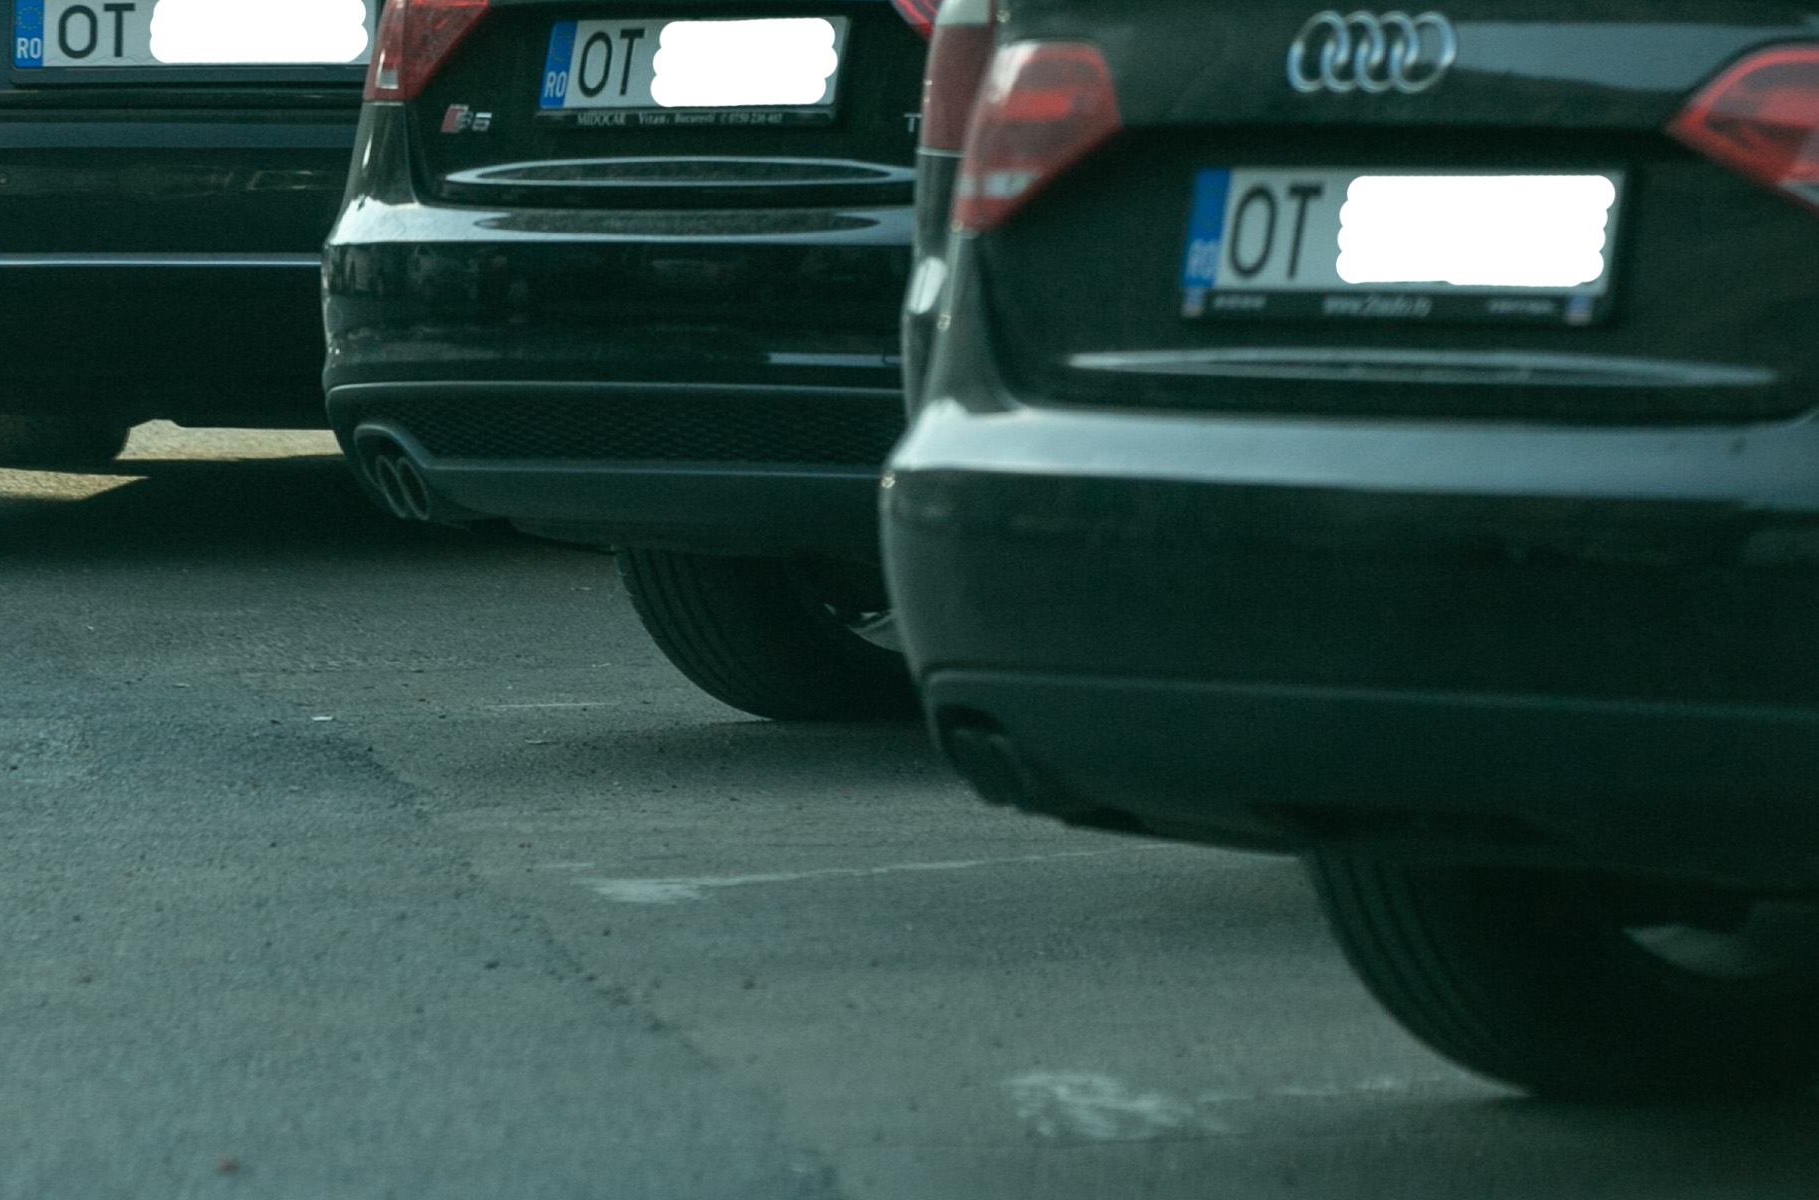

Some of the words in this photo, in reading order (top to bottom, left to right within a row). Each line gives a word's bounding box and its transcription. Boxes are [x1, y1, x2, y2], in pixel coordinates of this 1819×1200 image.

[16, 37, 43, 60] RO
[57, 2, 136, 59] OT
[577, 27, 646, 98] OT
[544, 70, 568, 99] RO
[903, 112, 922, 132] T
[1227, 182, 1325, 281] OT
